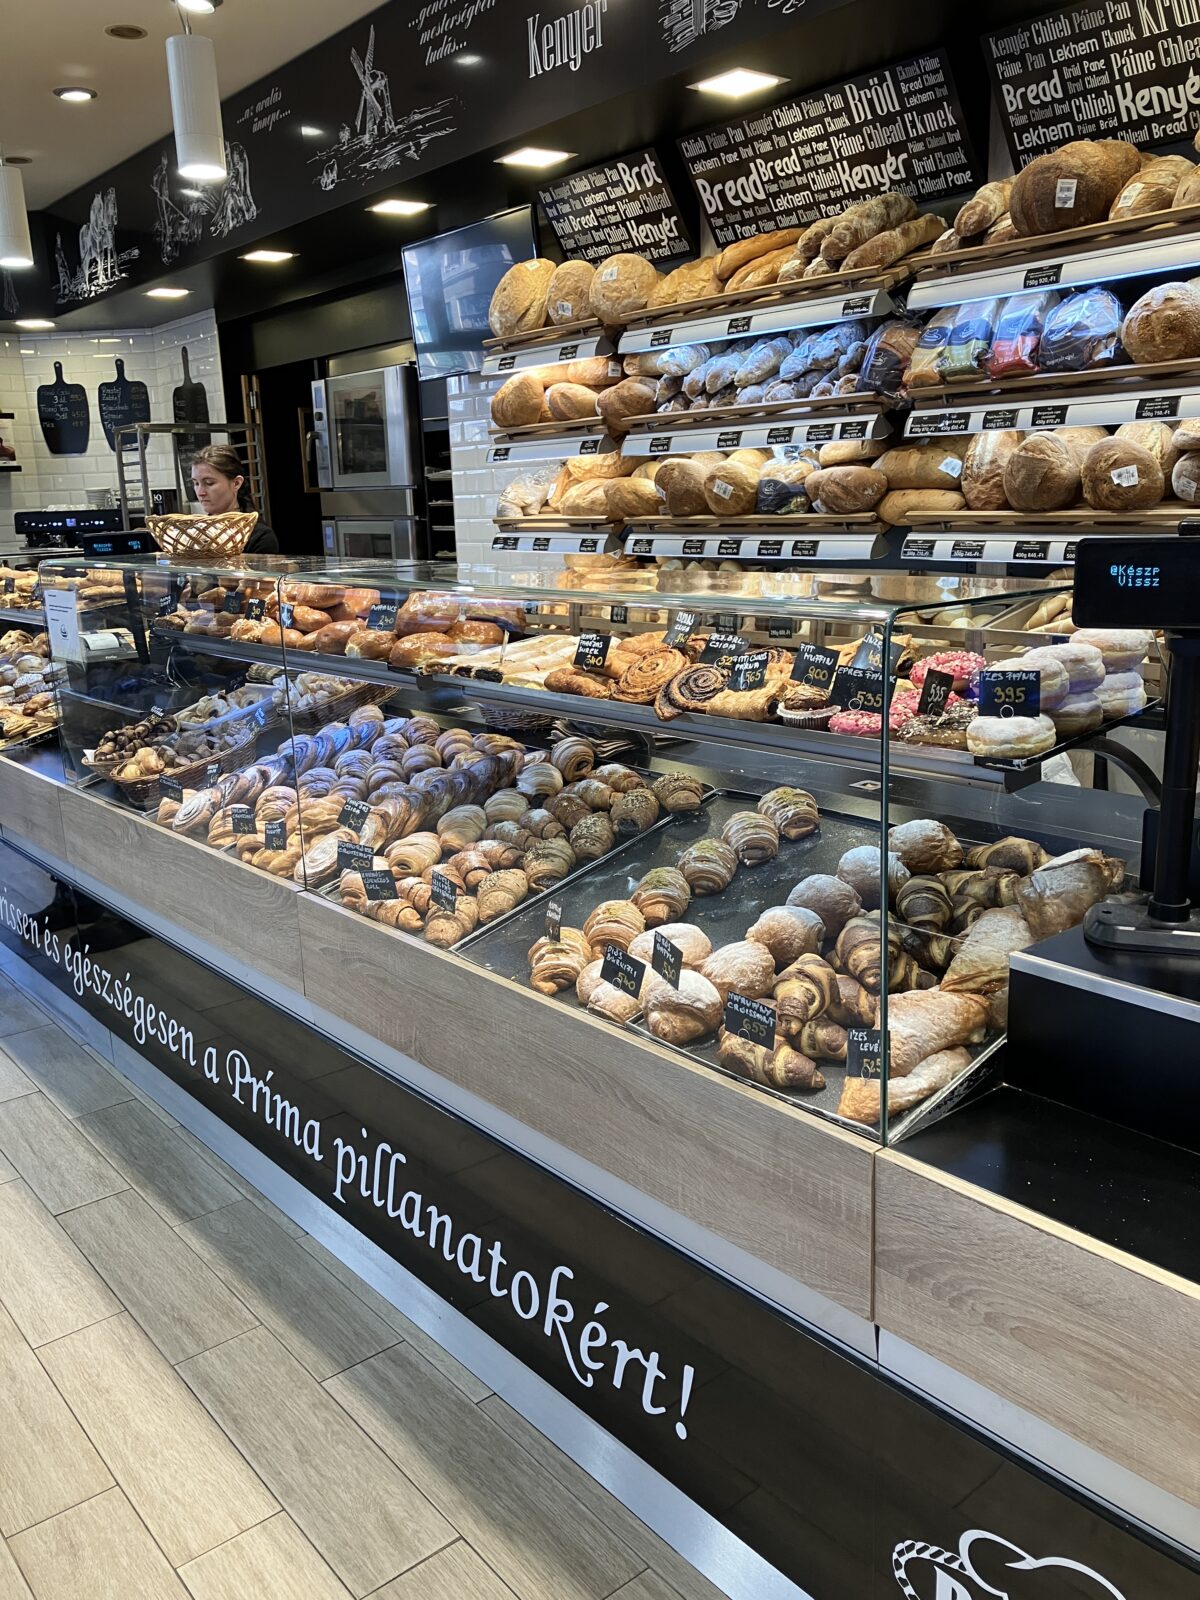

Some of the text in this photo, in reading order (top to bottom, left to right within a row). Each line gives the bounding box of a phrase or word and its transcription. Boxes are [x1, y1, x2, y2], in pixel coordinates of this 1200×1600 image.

[989, 29, 1030, 58] Kenyér
[1031, 14, 1071, 46] Chlieb
[1105, 1, 1131, 23] Pan
[1026, 52, 1046, 71] Pan
[1049, 38, 1099, 64] Lekhem
[1101, 23, 1137, 49] Ekmek
[900, 77, 923, 94] Bread
[1002, 69, 1063, 112] Bread
[1083, 58, 1106, 74] Pane
[1110, 47, 1156, 80] Páine
[727, 126, 745, 144] Pan
[772, 103, 803, 128] Chlieb
[824, 92, 845, 112] Pan
[843, 70, 901, 124] Bröd
[1071, 90, 1116, 122] Chlieb
[689, 155, 725, 175] Lekhem
[720, 150, 740, 166] Pane
[773, 134, 788, 149] Pan
[787, 123, 824, 144] Lekhem
[904, 89, 935, 108] Lekhem
[1013, 121, 1074, 150] Lekhem
[1152, 116, 1188, 139] Bread
[696, 162, 767, 214] Bread
[755, 147, 801, 182] Bread
[829, 132, 865, 159] Páine
[862, 115, 906, 150] Chlead
[903, 101, 957, 139] Ekmek
[806, 166, 841, 192] Chlieb
[836, 148, 909, 194] Kenyér
[617, 153, 663, 194] Brot
[769, 190, 814, 213] Lekhem
[912, 153, 937, 176] Bröd
[933, 145, 968, 169] Ekmek
[580, 190, 608, 207] Lekhem
[734, 221, 758, 238] Pane
[820, 201, 842, 218] Pane
[947, 169, 973, 187] Pane
[569, 209, 598, 232] Bread
[626, 212, 678, 247] Kenyér
[1118, 575, 1160, 587] Vissz
[709, 641, 736, 650] CSIGA
[746, 669, 763, 682] 565
[808, 666, 829, 681] 900
[838, 667, 864, 677] EPRES
[857, 690, 882, 708] 535
[993, 687, 1026, 704] 395
[742, 1018, 767, 1037] 655
[43, 916, 61, 964] és
[64, 944, 197, 1067] egészségesen
[203, 1046, 220, 1084] a
[226, 1049, 324, 1161] Príma
[332, 1127, 695, 1440] pillanatokért!
